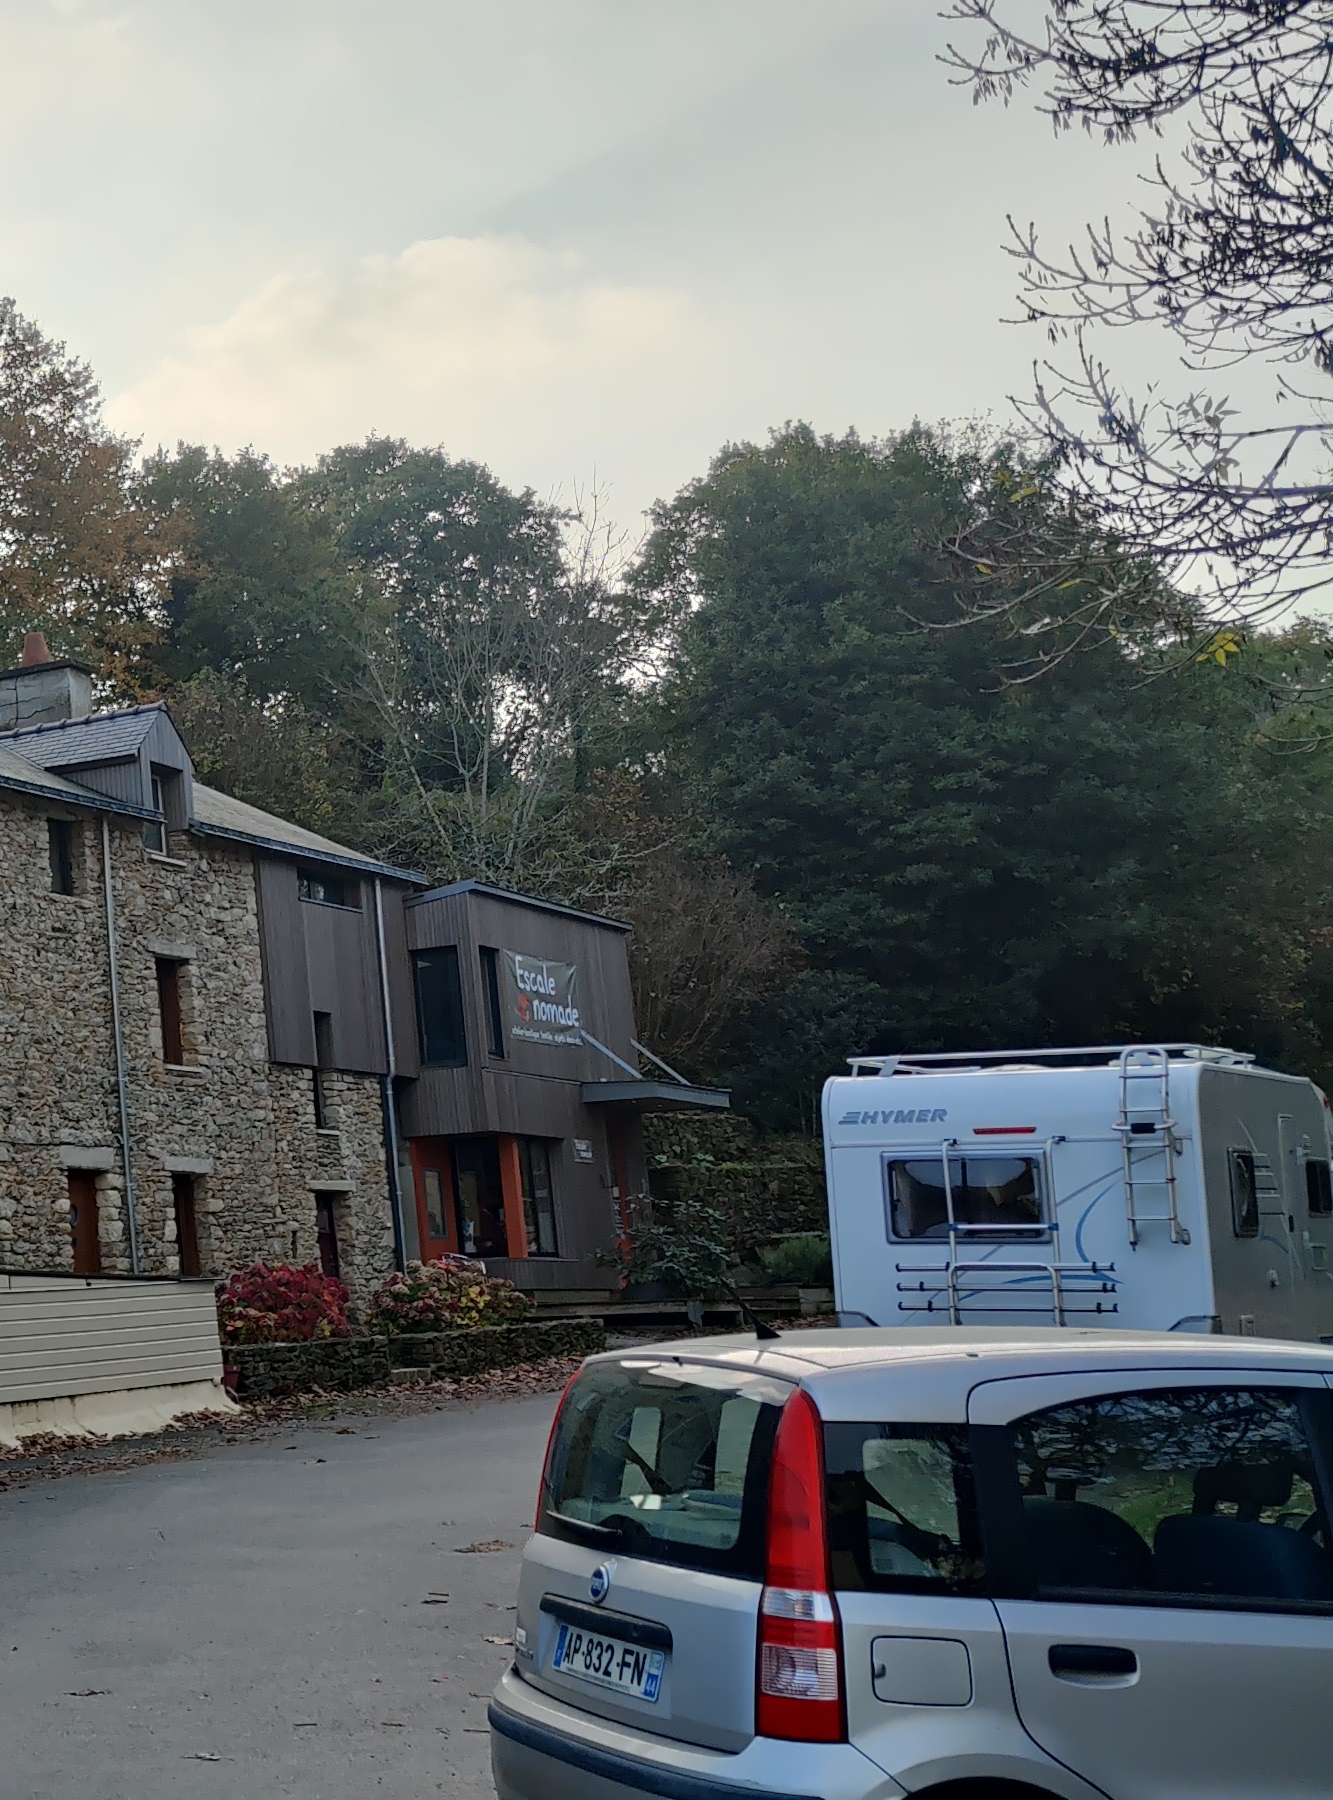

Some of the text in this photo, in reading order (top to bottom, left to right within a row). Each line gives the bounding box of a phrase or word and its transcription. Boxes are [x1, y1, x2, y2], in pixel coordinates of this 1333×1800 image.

[515, 955, 556, 996] Escale
[533, 994, 580, 1028] nomade
[861, 1108, 948, 1125] HYMER
[645, 1678, 657, 1694] 44
